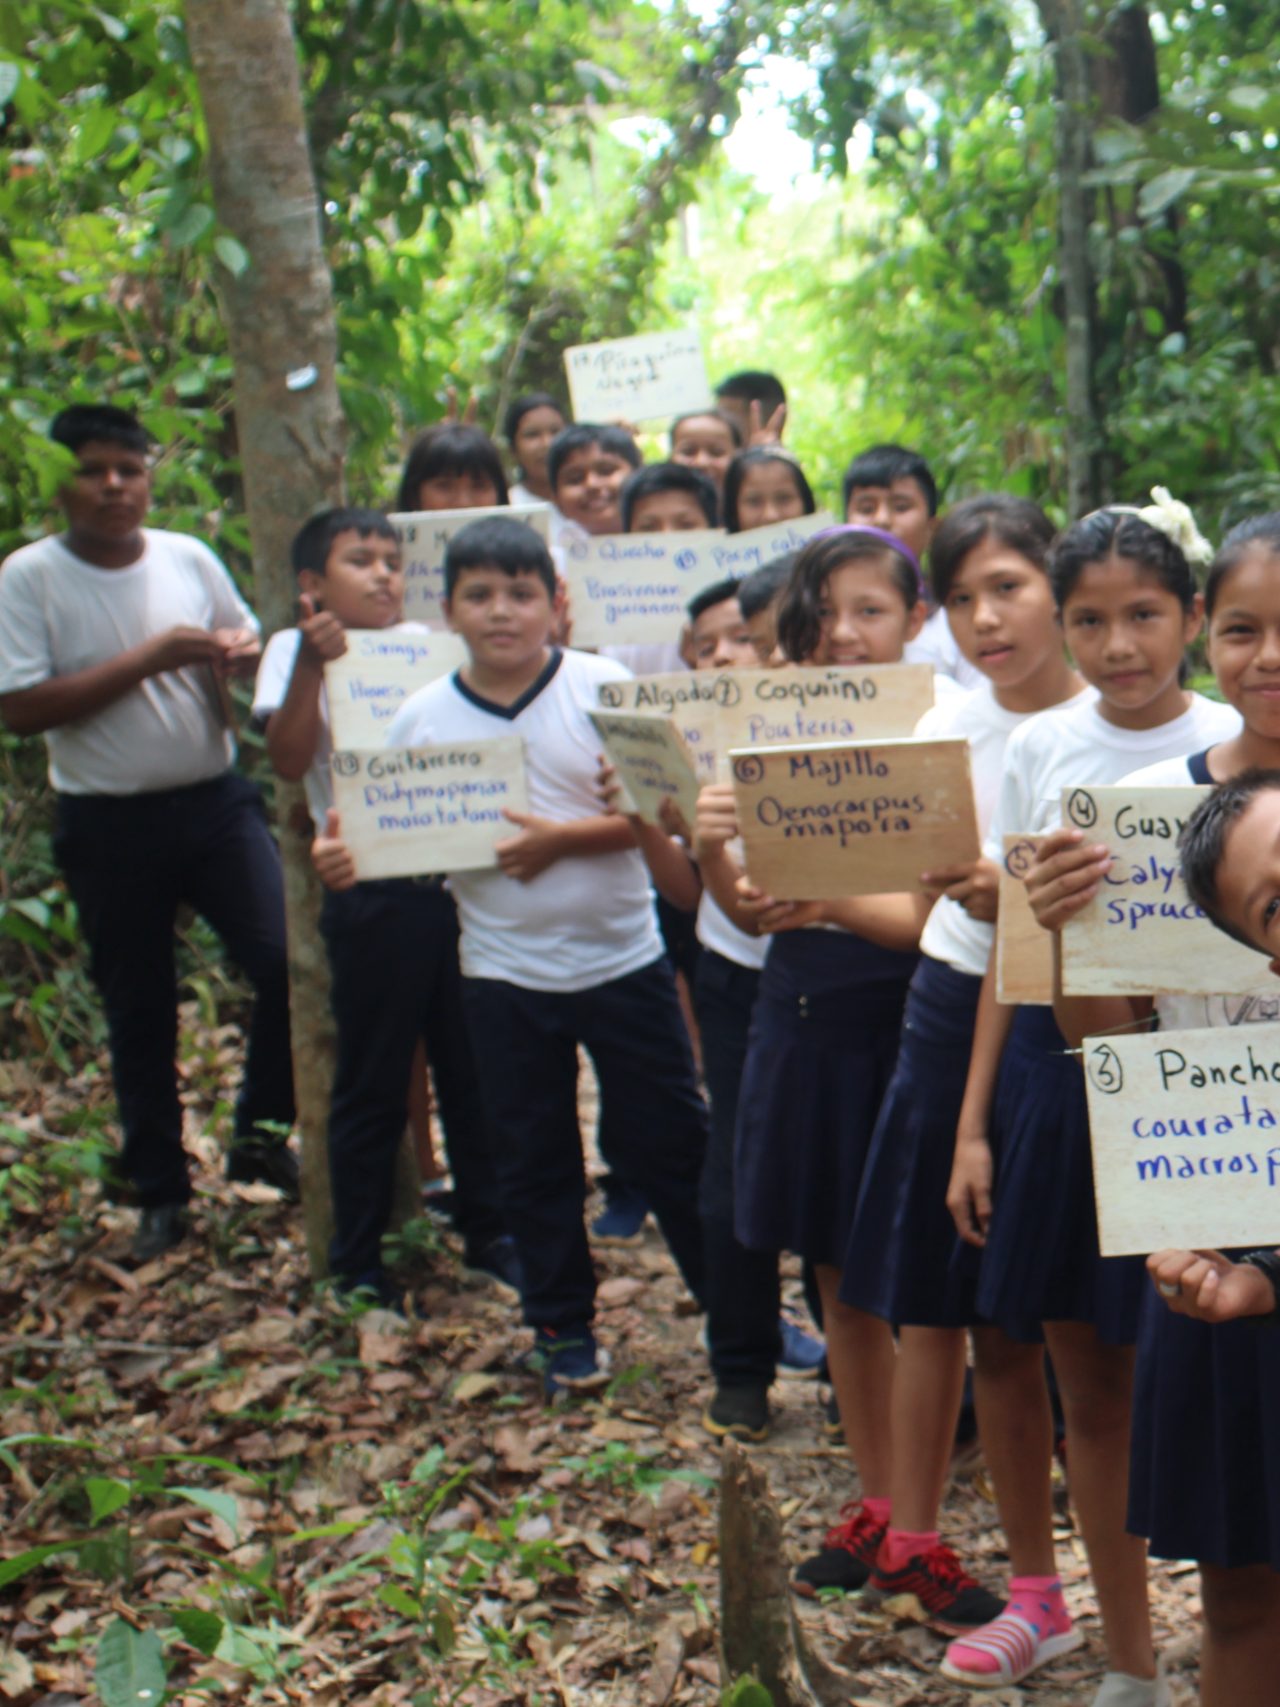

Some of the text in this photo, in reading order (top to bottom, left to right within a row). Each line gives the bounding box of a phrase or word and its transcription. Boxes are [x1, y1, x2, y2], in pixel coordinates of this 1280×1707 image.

[747, 711, 854, 742] Pouteria
[789, 750, 890, 787] Majillo
[757, 794, 925, 827] Oenocarpus
